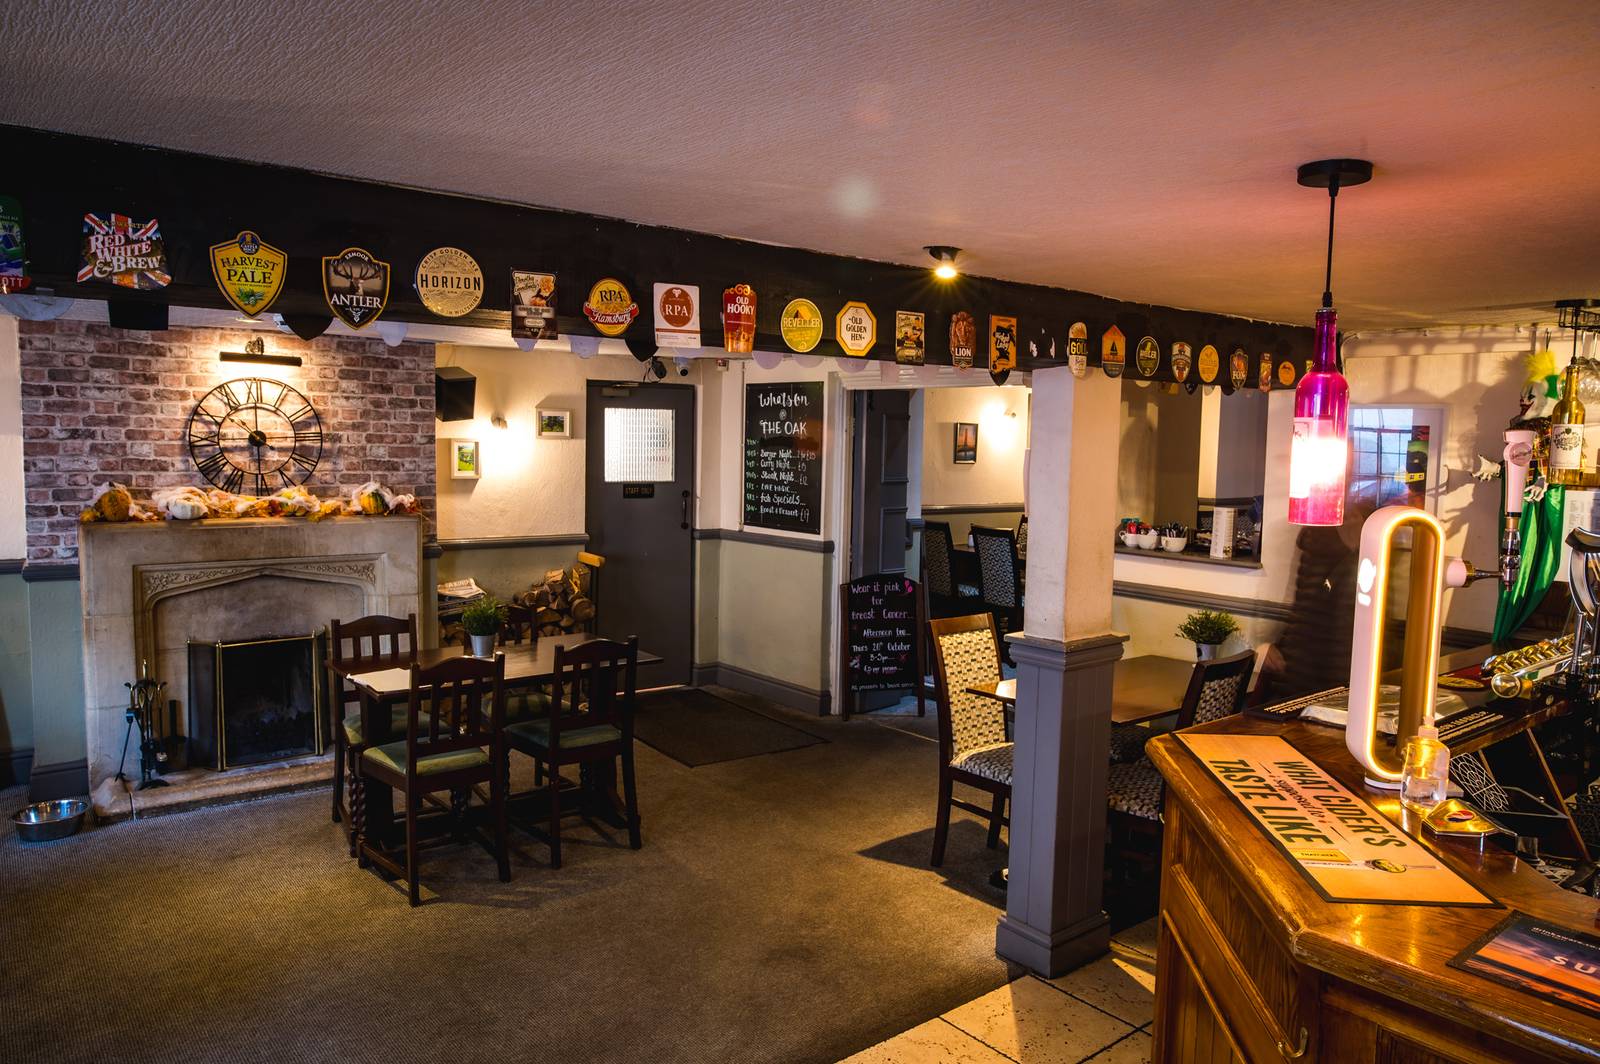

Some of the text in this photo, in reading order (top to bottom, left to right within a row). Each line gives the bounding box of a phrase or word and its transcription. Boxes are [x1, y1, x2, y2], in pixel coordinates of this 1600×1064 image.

[89, 234, 126, 254] RED
[96, 241, 152, 262] WHITE
[344, 252, 369, 262] EXMOOR
[439, 248, 468, 260] GOLDEN
[93, 255, 161, 279] & BREW
[221, 256, 279, 272] HARVEST
[226, 268, 274, 285] PALE
[420, 273, 481, 291] HORIZON
[330, 293, 383, 309] ANTLER
[600, 289, 624, 302] RPA
[735, 296, 750, 305] OLD
[590, 308, 632, 324] Ramsbury
[665, 304, 689, 317] RPA
[727, 303, 755, 316] HOOKY
[851, 316, 863, 325] OLD
[846, 324, 867, 333] GOLDEN
[850, 333, 862, 341] HEN
[955, 347, 972, 357] LION
[760, 420, 807, 435] THE OAK
[760, 449, 777, 461] Burger
[760, 459, 775, 471] Curry
[761, 471, 778, 481] Steak
[851, 584, 870, 594] Wear
[873, 582, 880, 592] it
[887, 642, 911, 652] October
[1208, 759, 1336, 846] TASTE LIKE
[1273, 761, 1408, 848] WHAT CIDER'S
